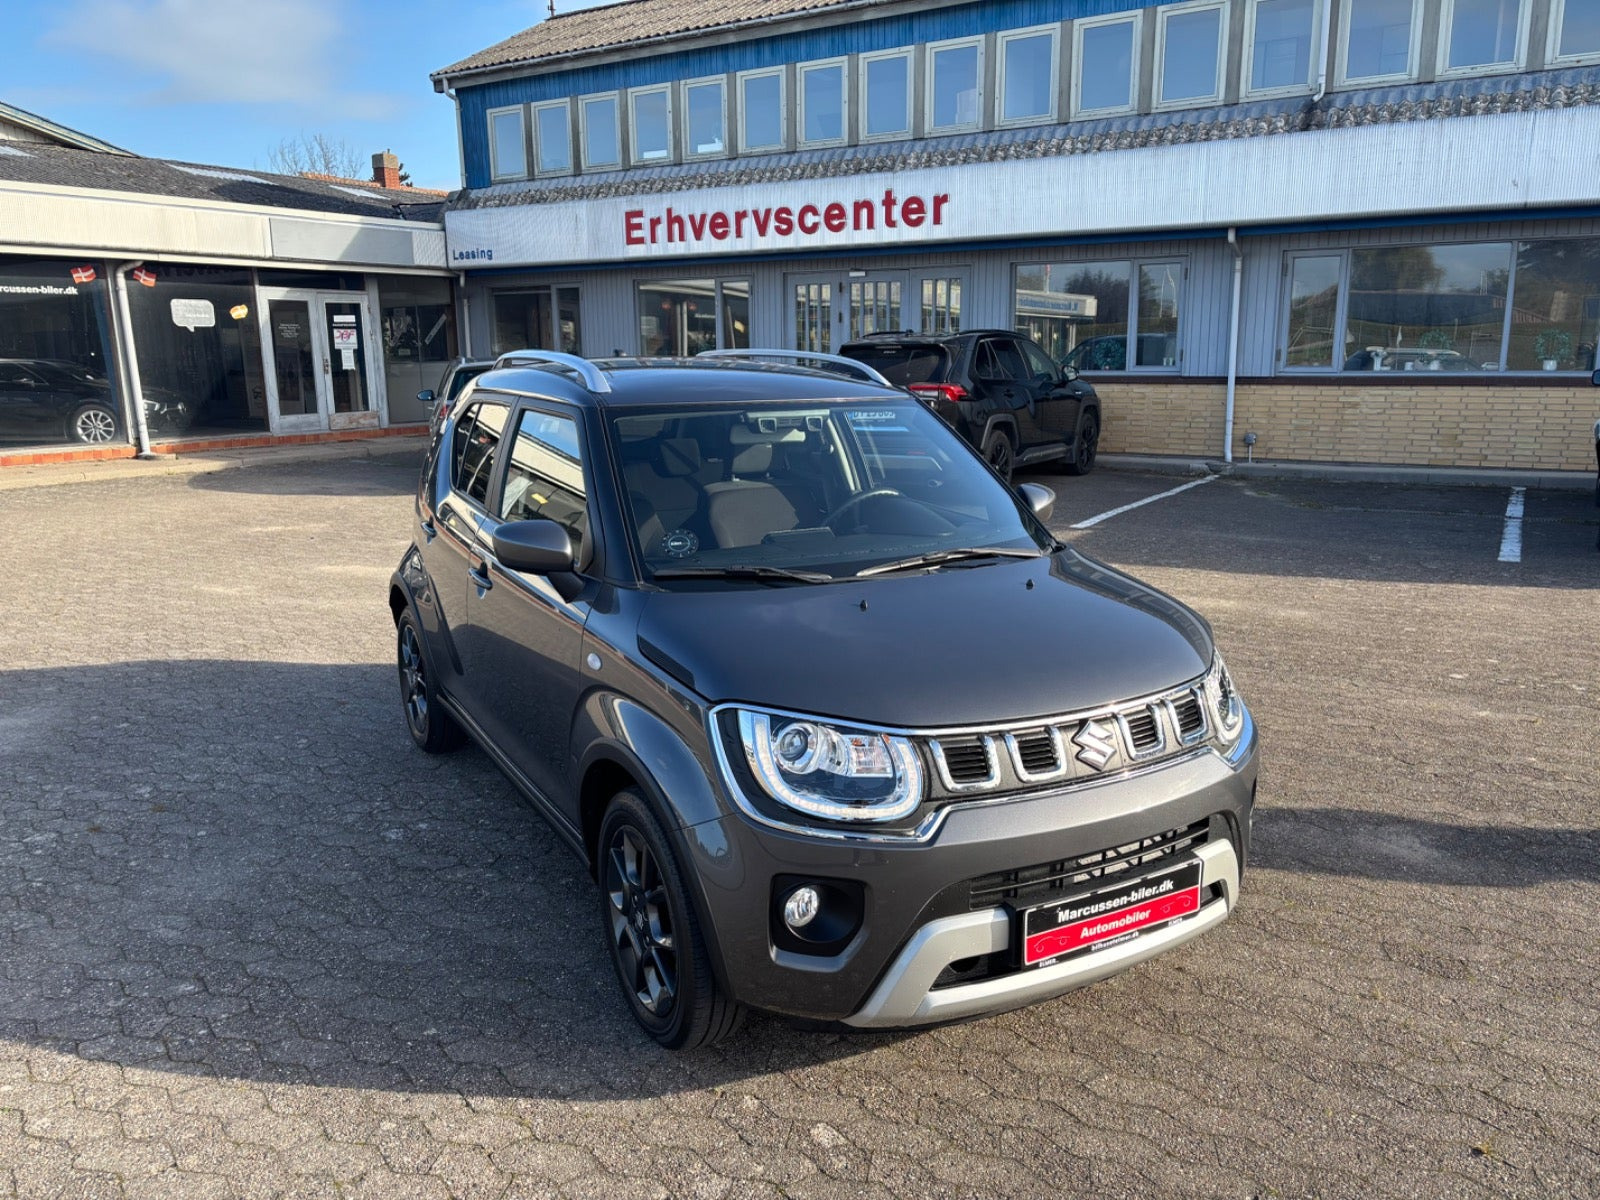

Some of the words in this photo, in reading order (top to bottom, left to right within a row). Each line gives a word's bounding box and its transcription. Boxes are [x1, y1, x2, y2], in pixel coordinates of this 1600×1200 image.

[625, 189, 949, 245] Erhvervscenter
[453, 248, 493, 260] Leasing
[1057, 880, 1174, 923] Marcussen-biler.dk
[1080, 910, 1151, 938] Automobiler
